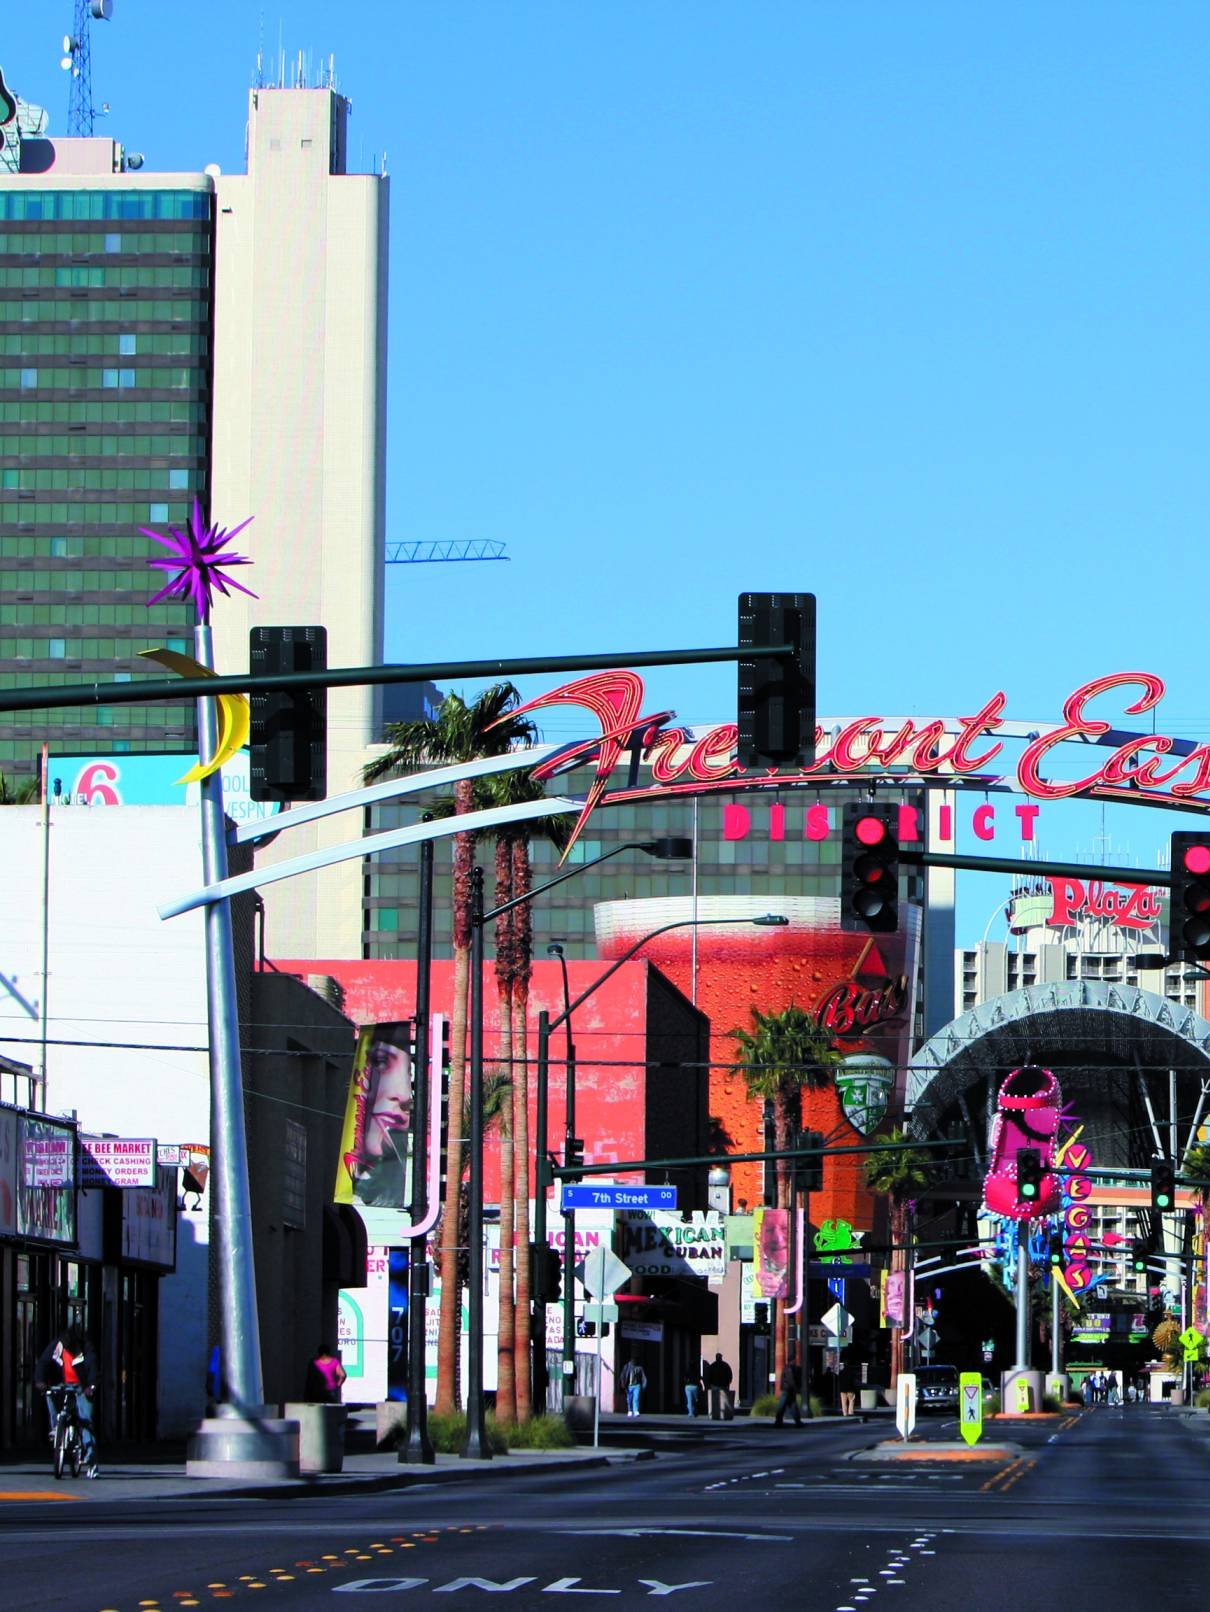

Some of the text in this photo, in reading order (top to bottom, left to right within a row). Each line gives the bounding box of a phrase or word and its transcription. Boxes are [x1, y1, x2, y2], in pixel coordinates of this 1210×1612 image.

[484, 669, 1007, 870] Freont
[723, 803, 1040, 841] DISRICT
[1045, 875, 1162, 930] Plaza
[95, 1143, 112, 1153] BEE
[114, 1143, 151, 1153] MARKET
[592, 1192, 611, 1204] 7th
[615, 1192, 649, 1204] Street
[1067, 1148, 1090, 1288] VEGAS
[625, 1227, 725, 1256] MEXICAN
[664, 1246, 723, 1259] CUBAN
[331, 1577, 715, 1595] ONLY
